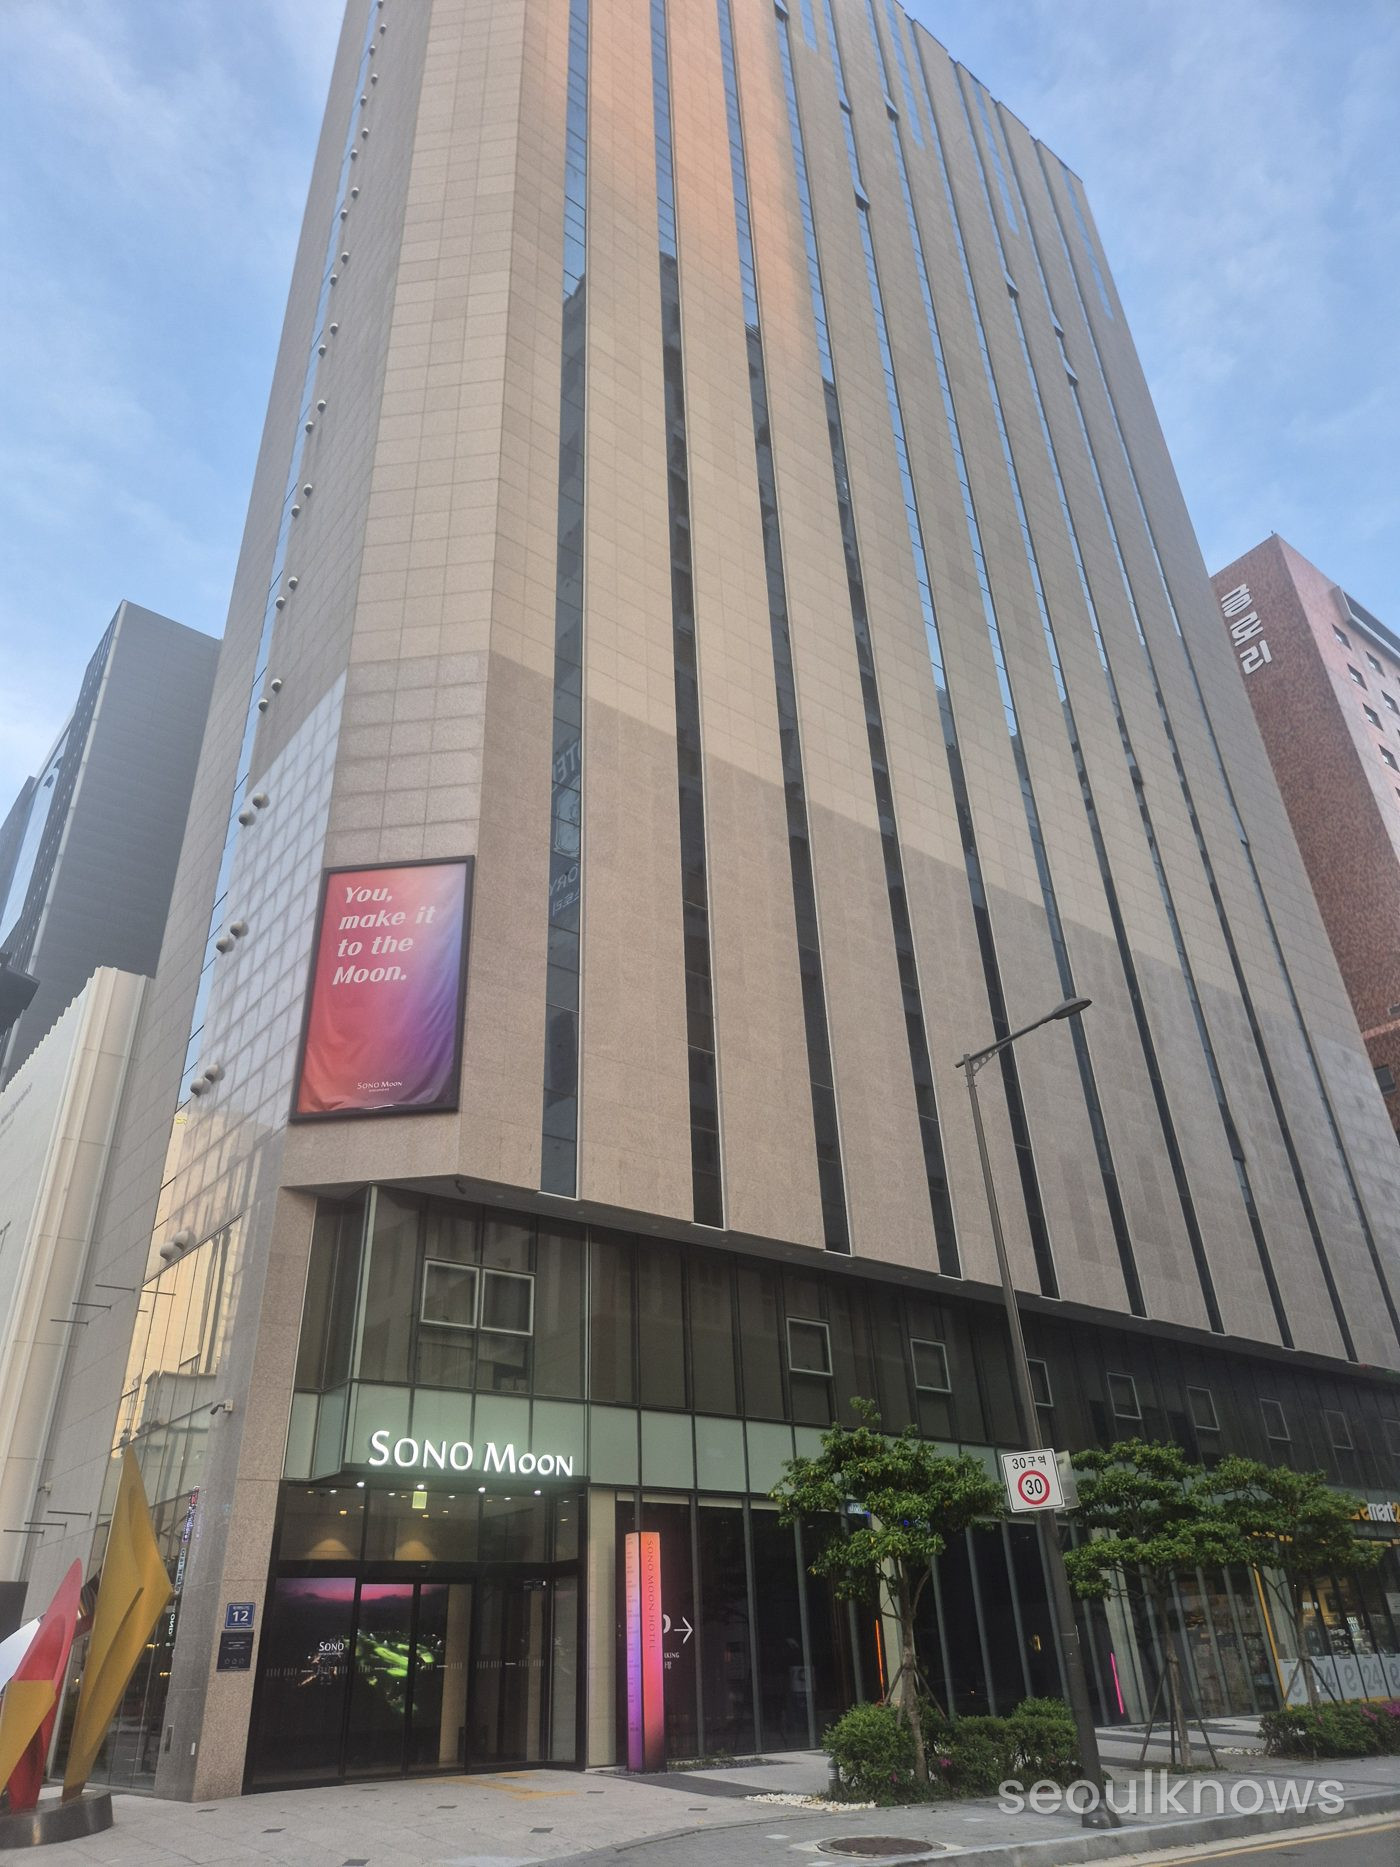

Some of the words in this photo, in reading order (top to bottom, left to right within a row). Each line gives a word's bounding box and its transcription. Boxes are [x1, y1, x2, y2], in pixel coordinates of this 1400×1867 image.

[1221, 584, 1272, 675] 글로리
[345, 886, 393, 904] You,
[338, 909, 406, 930] make
[415, 905, 436, 924] it
[337, 938, 363, 957] to
[371, 935, 414, 955] the
[332, 965, 407, 985] Moon.
[368, 1430, 473, 1470] SONO
[1012, 1455, 1047, 1470] 30구역
[1025, 1478, 1043, 1495] 30
[647, 1575, 655, 1611] MOON
[232, 1610, 249, 1622] 12
[318, 1641, 345, 1652] SONO
